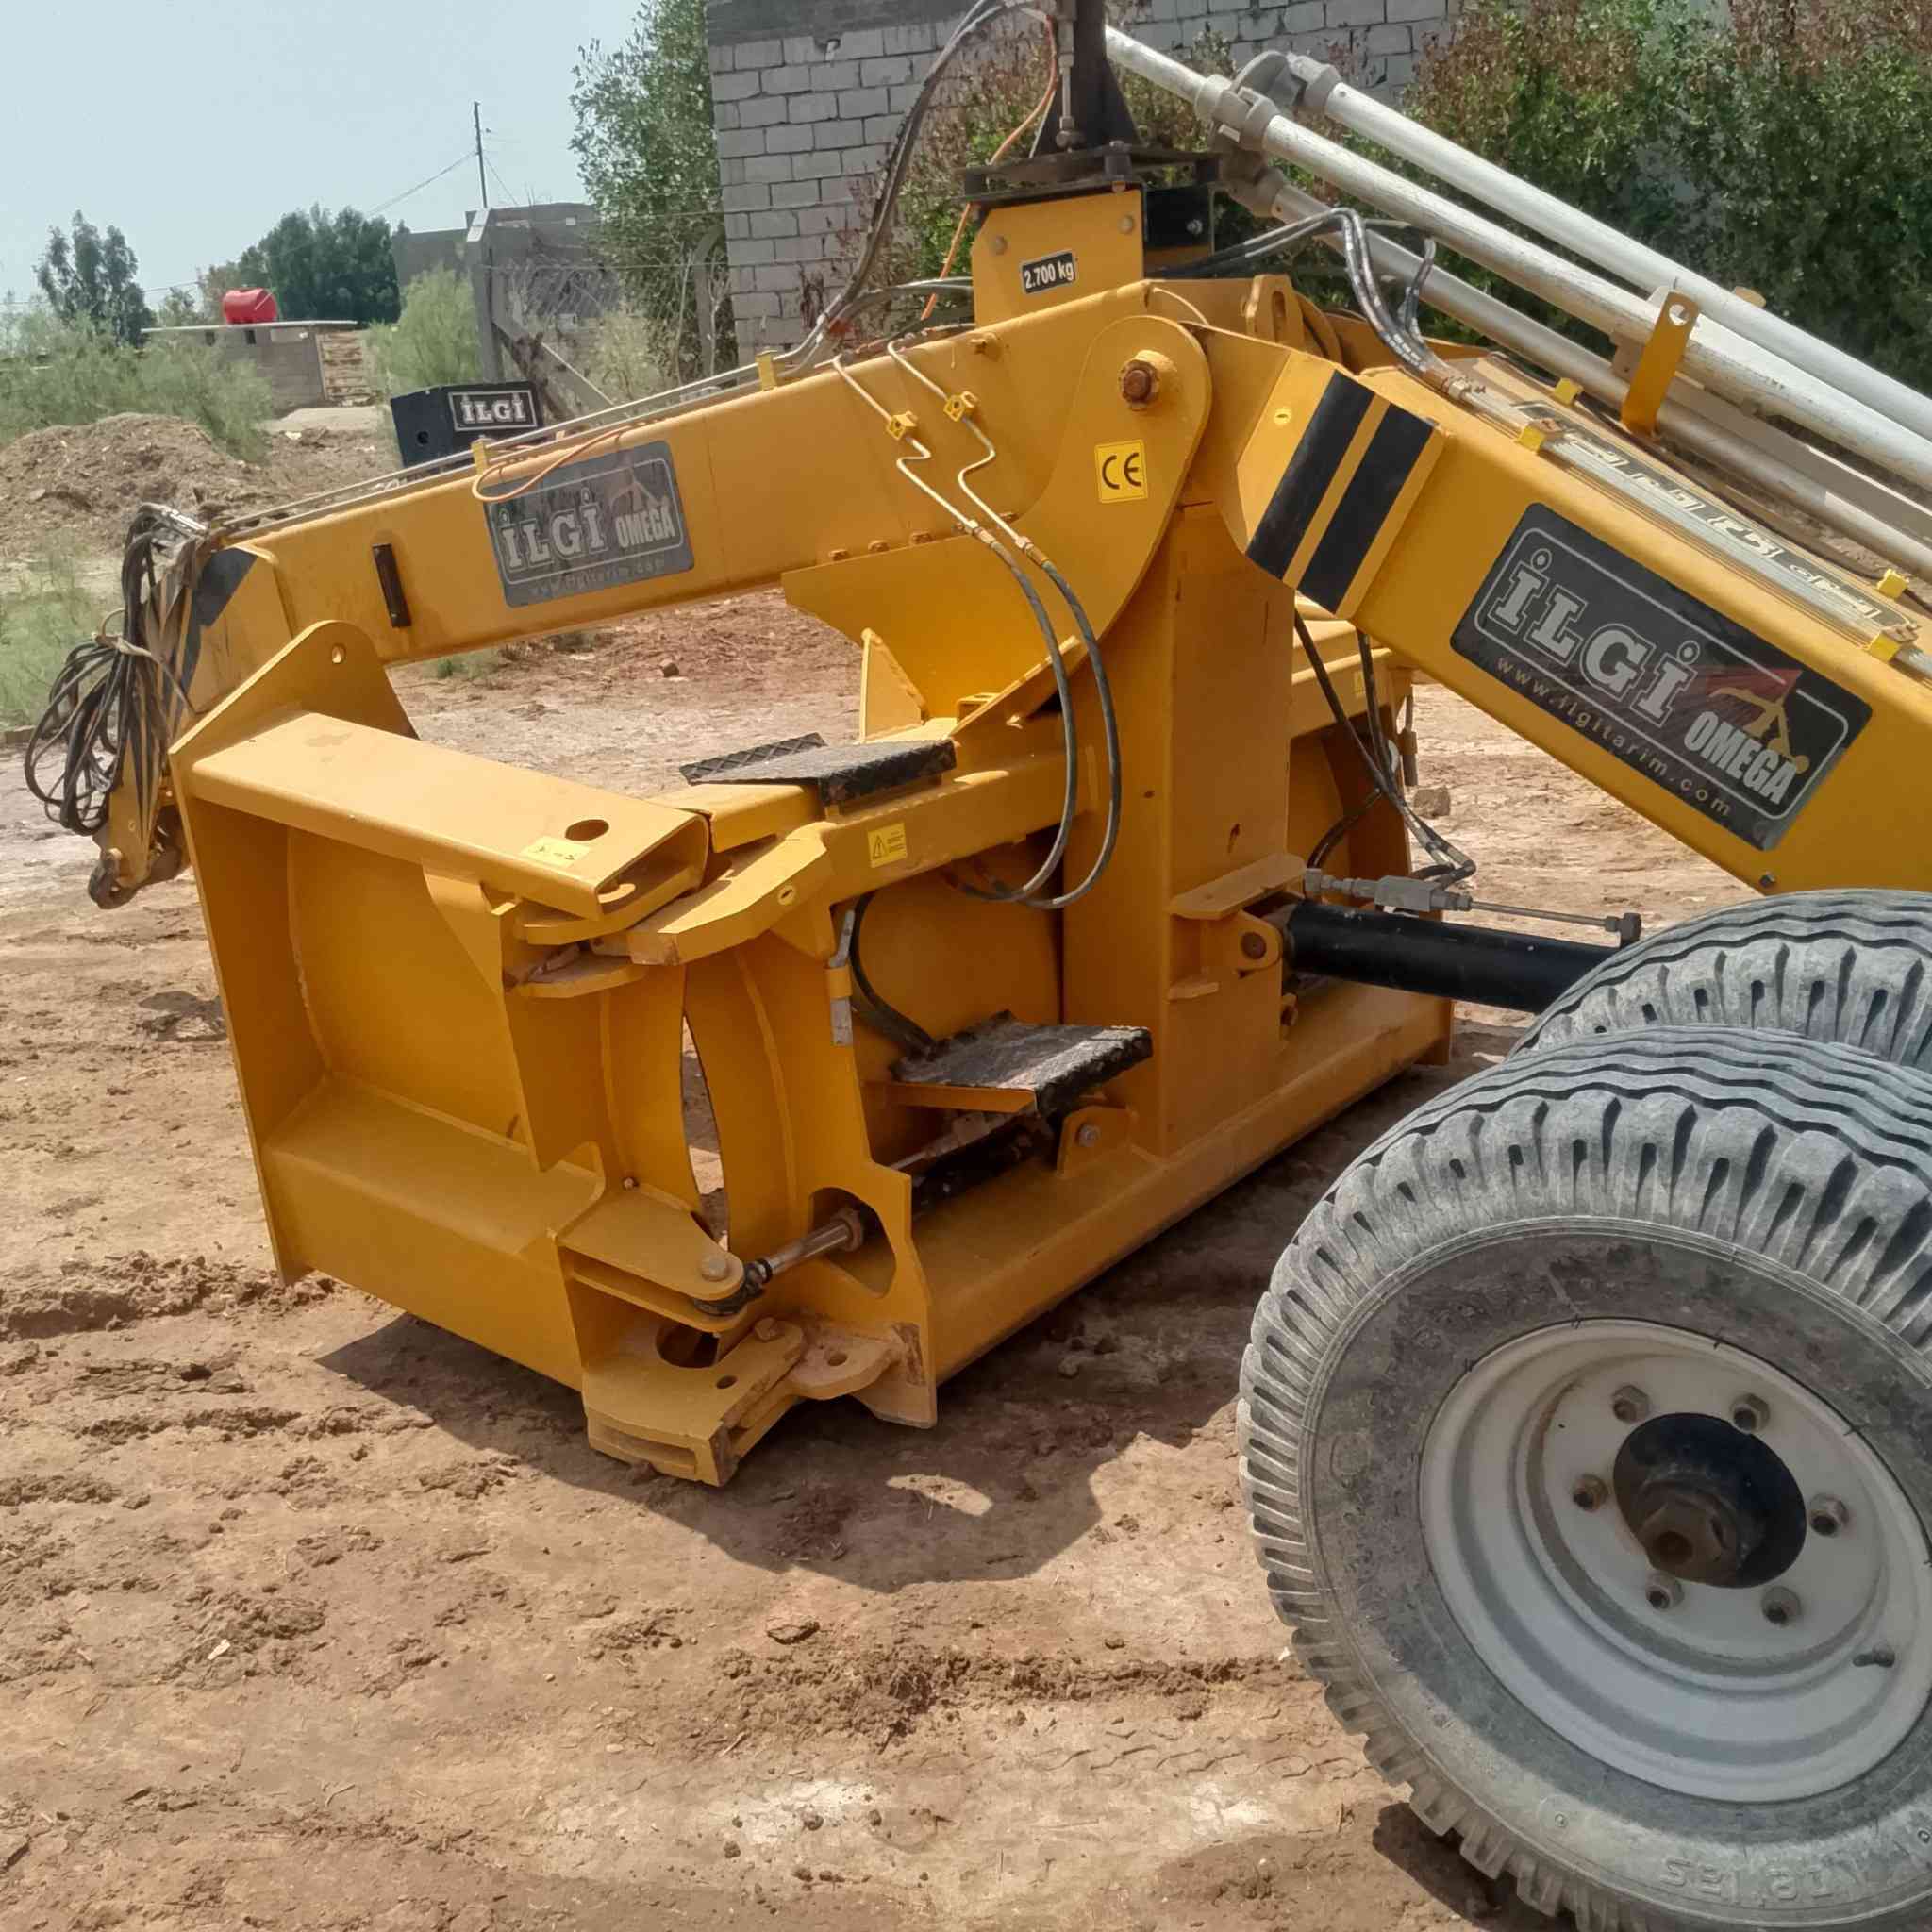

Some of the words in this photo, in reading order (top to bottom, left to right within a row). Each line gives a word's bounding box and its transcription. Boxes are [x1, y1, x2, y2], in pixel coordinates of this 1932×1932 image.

[1024, 263, 1057, 289] 2.700
[1058, 260, 1074, 281] kg
[1102, 452, 1141, 489] CE
[615, 500, 676, 549] OMEGA
[1684, 710, 1798, 805] OMEGA
